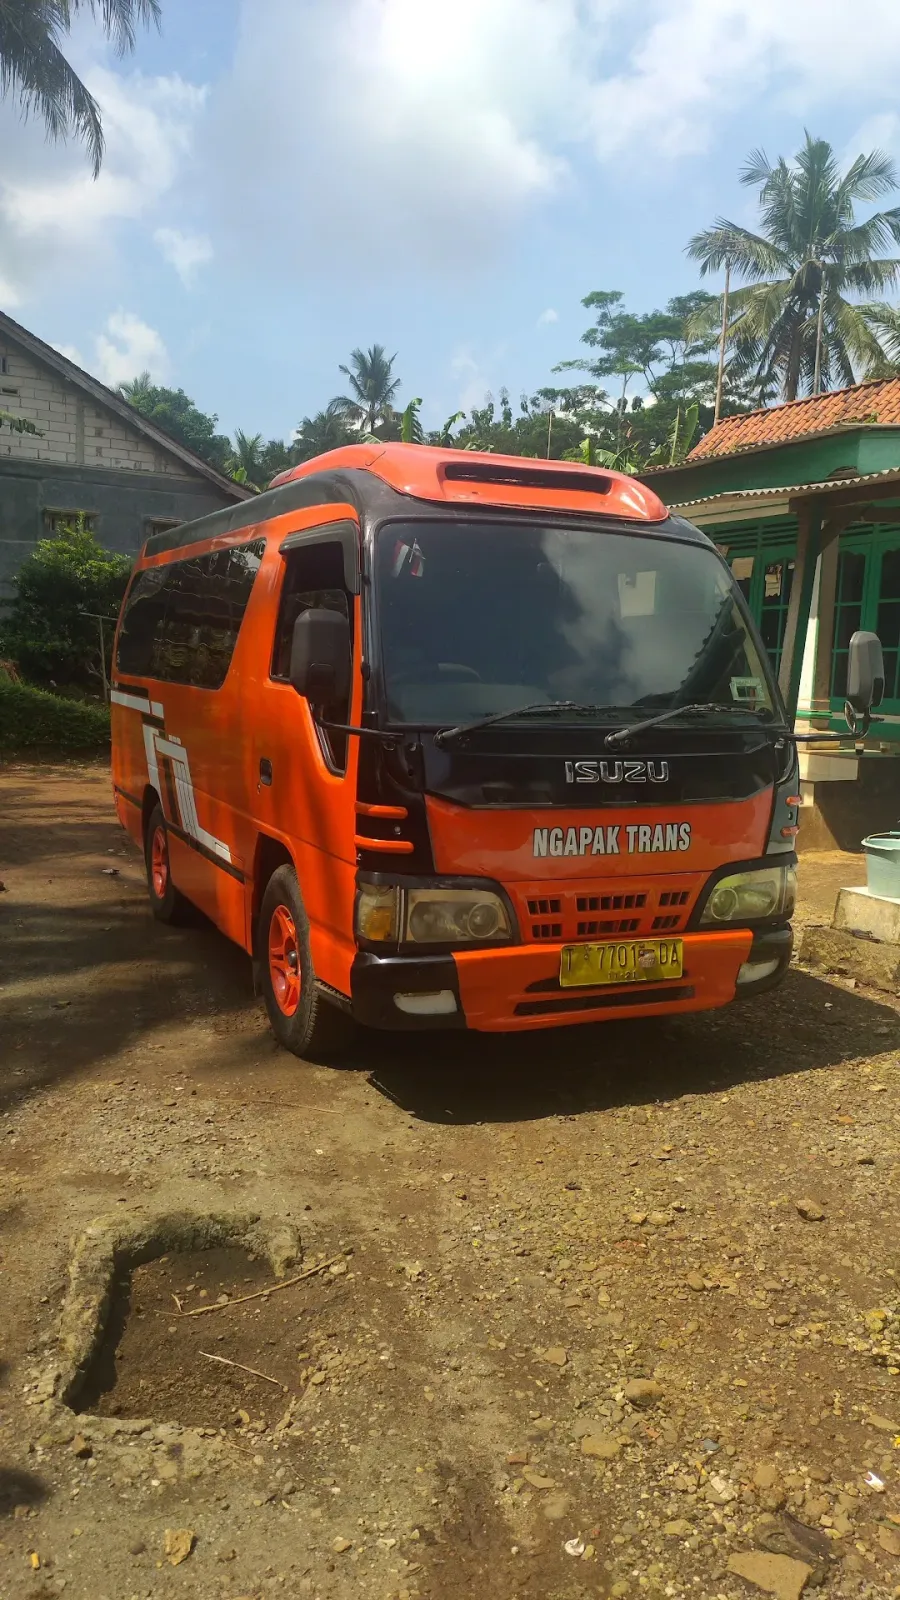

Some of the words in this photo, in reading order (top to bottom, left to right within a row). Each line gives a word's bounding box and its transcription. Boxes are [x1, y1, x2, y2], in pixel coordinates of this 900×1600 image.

[564, 761, 669, 783] ISUZU
[532, 825, 621, 858] NGAPAK
[625, 822, 692, 854] TRANS
[566, 947, 574, 971] T
[596, 944, 637, 970] 7701
[659, 942, 679, 966] DA
